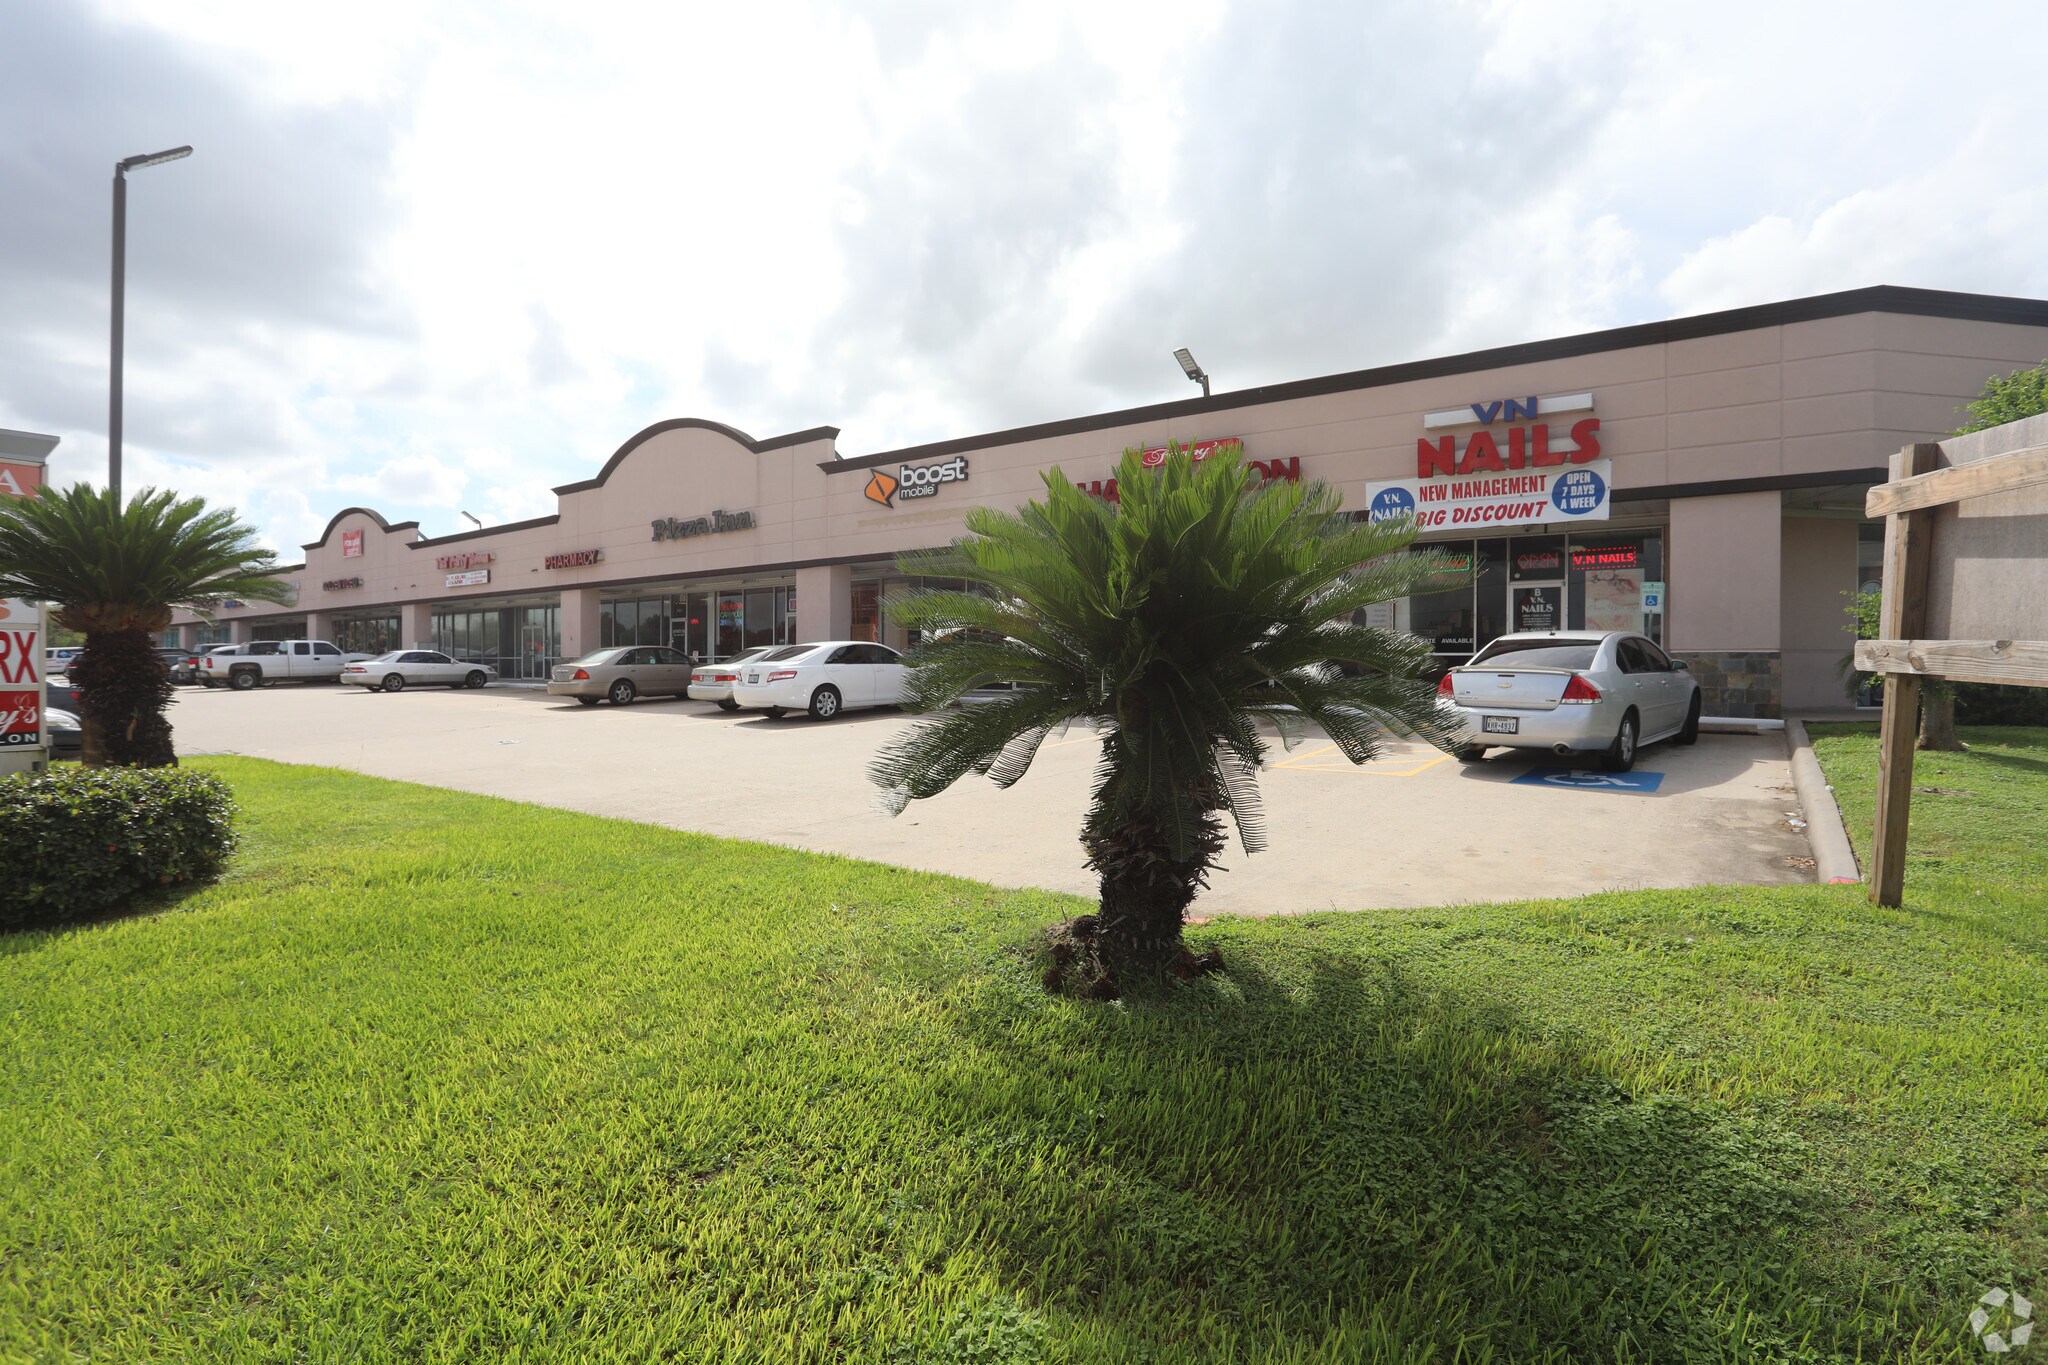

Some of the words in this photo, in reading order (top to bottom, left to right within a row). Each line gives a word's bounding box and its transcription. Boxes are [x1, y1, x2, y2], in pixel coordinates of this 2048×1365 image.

[1471, 396, 1538, 424] VN
[1417, 418, 1601, 478] NAILS
[900, 457, 966, 486] boost
[1566, 472, 1591, 484] OPEN
[901, 485, 935, 498] mobile
[1419, 484, 1448, 502] NEW
[1451, 475, 1547, 500] MANAGEMENT
[1562, 487, 1569, 496] 7
[1570, 485, 1595, 496] DAYS
[1560, 500, 1568, 509] A
[1569, 496, 1596, 509] WEEK
[1416, 509, 1447, 527] BIG
[1452, 501, 1548, 524] DISCOUNT
[651, 517, 709, 541] Pizza
[712, 509, 752, 533] Inn
[544, 549, 599, 570] PHARMACY
[1517, 552, 1559, 569] OPEN
[1599, 552, 1635, 563] NAILS
[1534, 588, 1541, 597] B
[1521, 603, 1553, 613] NAILS
